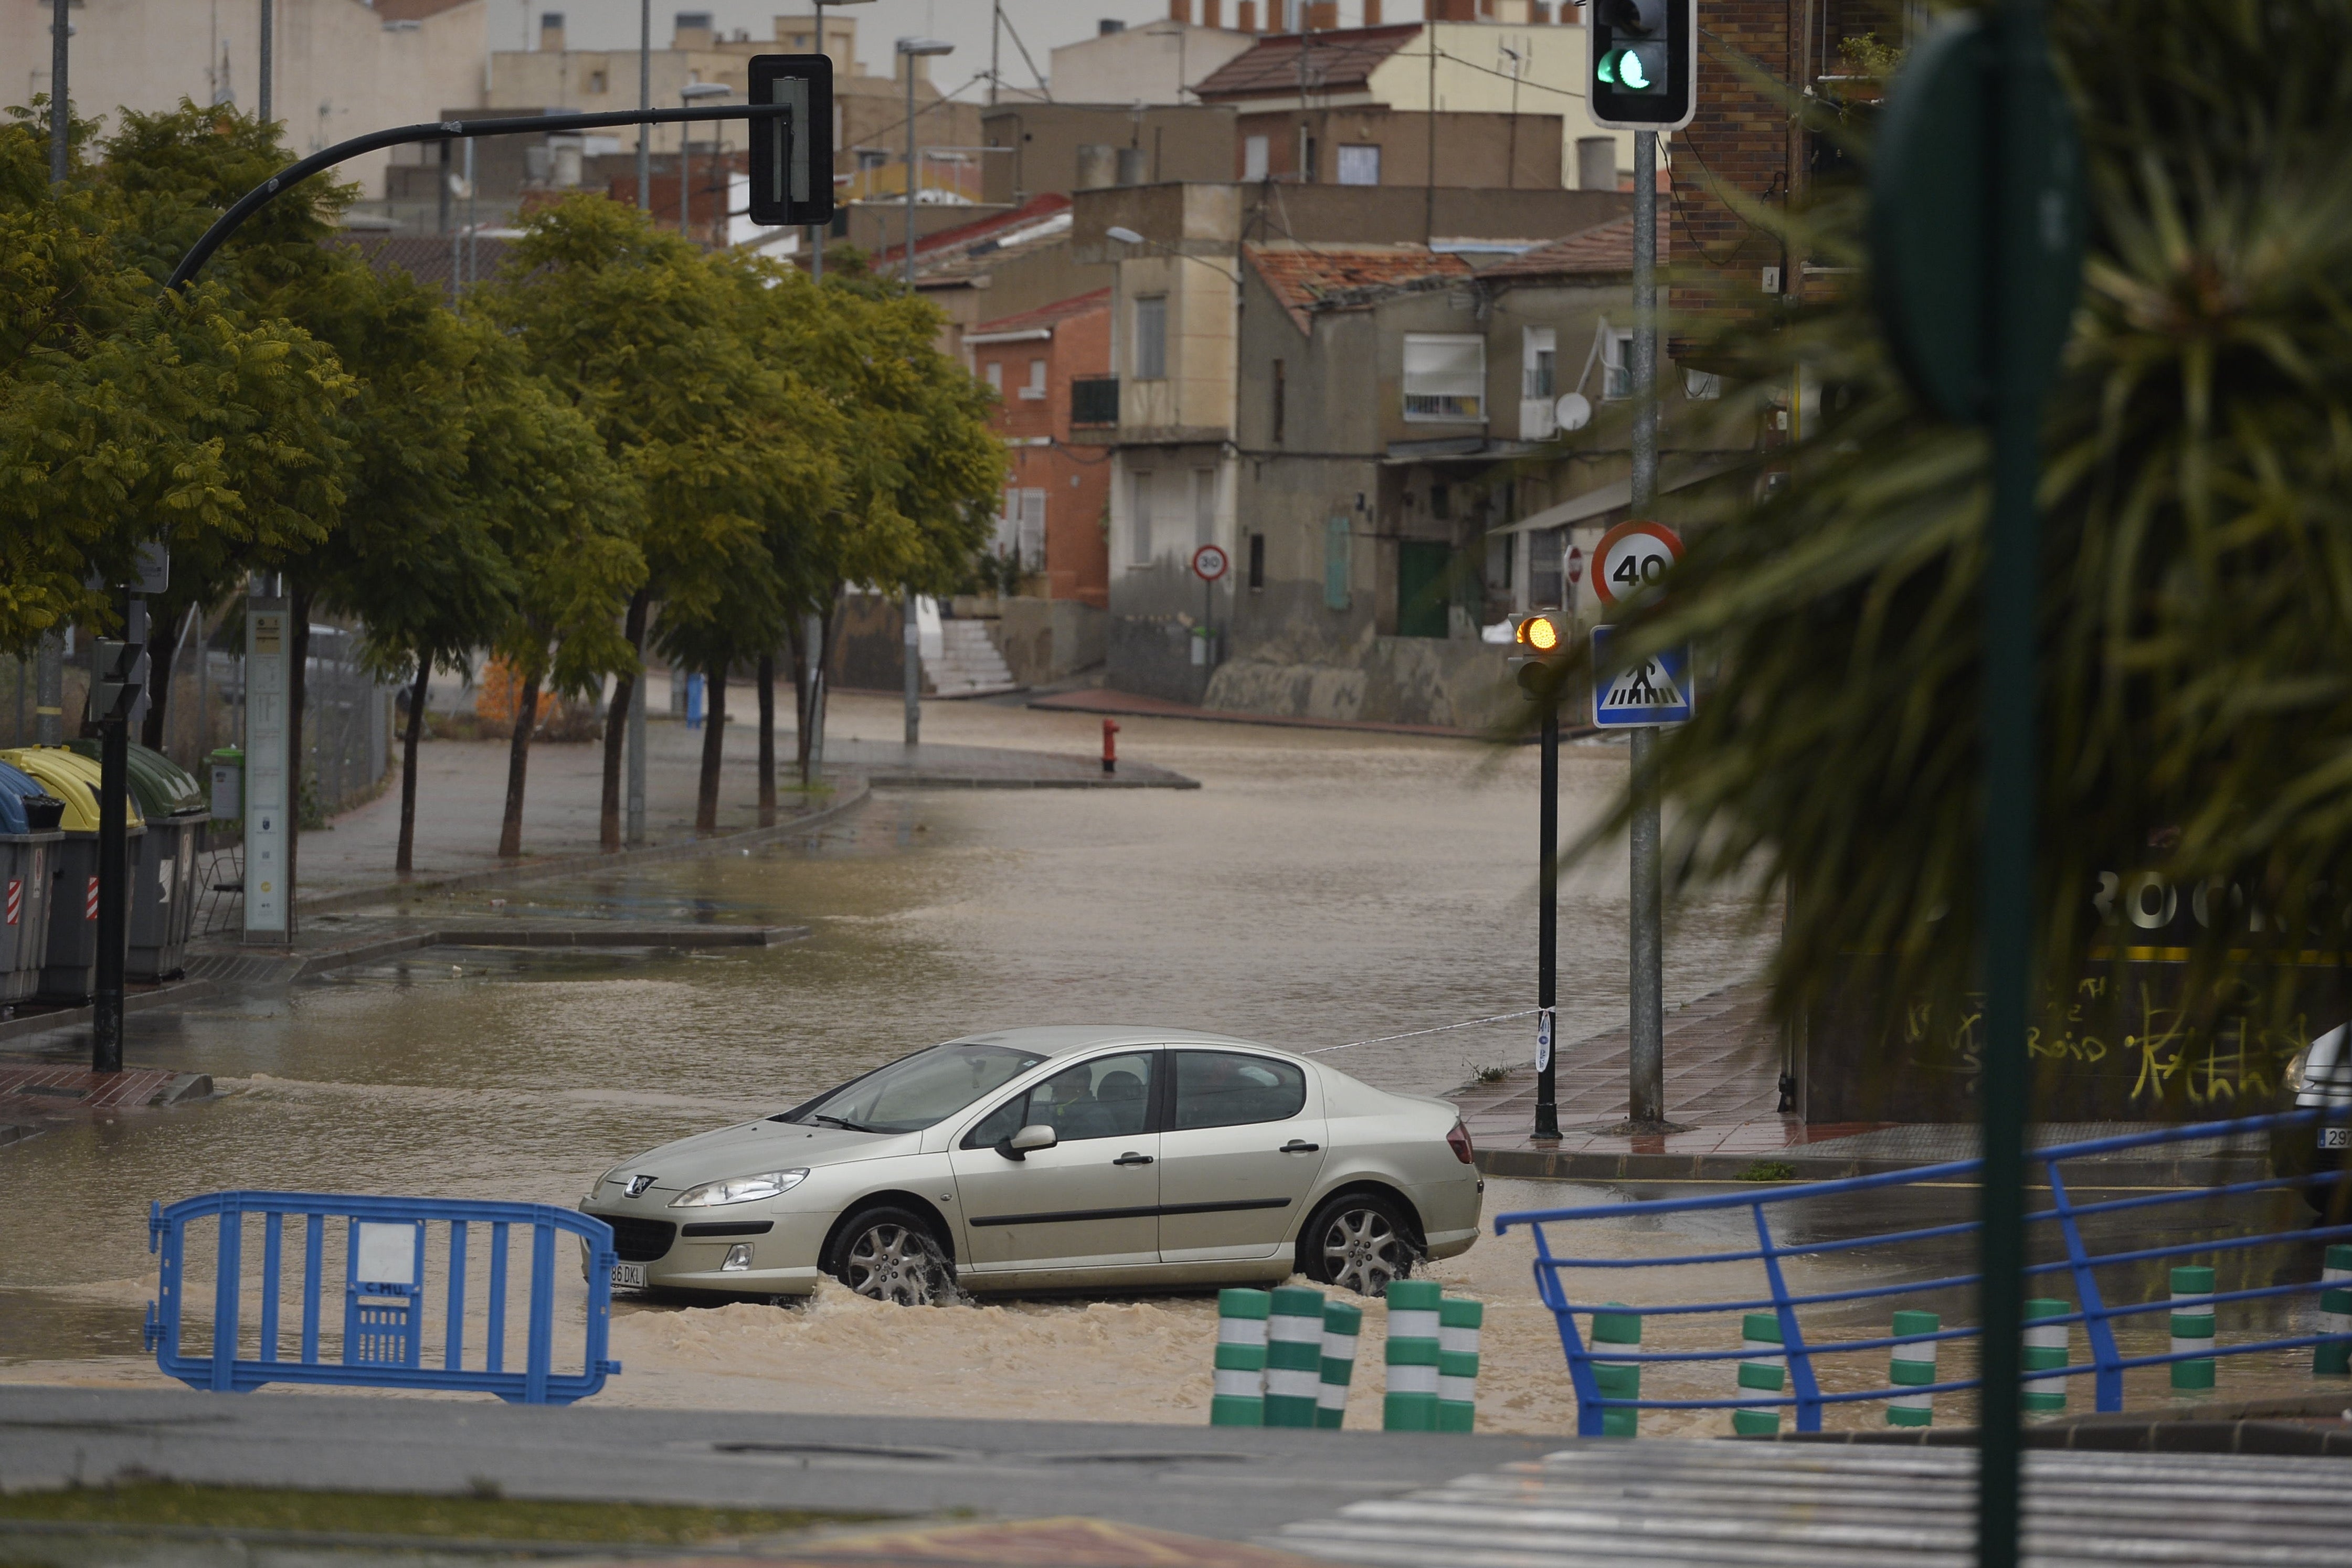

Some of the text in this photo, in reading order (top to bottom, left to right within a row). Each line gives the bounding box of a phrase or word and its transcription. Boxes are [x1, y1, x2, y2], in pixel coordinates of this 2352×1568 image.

[1199, 556, 1221, 568] 30
[1613, 554, 1667, 586] 40
[624, 1266, 640, 1284] DKL
